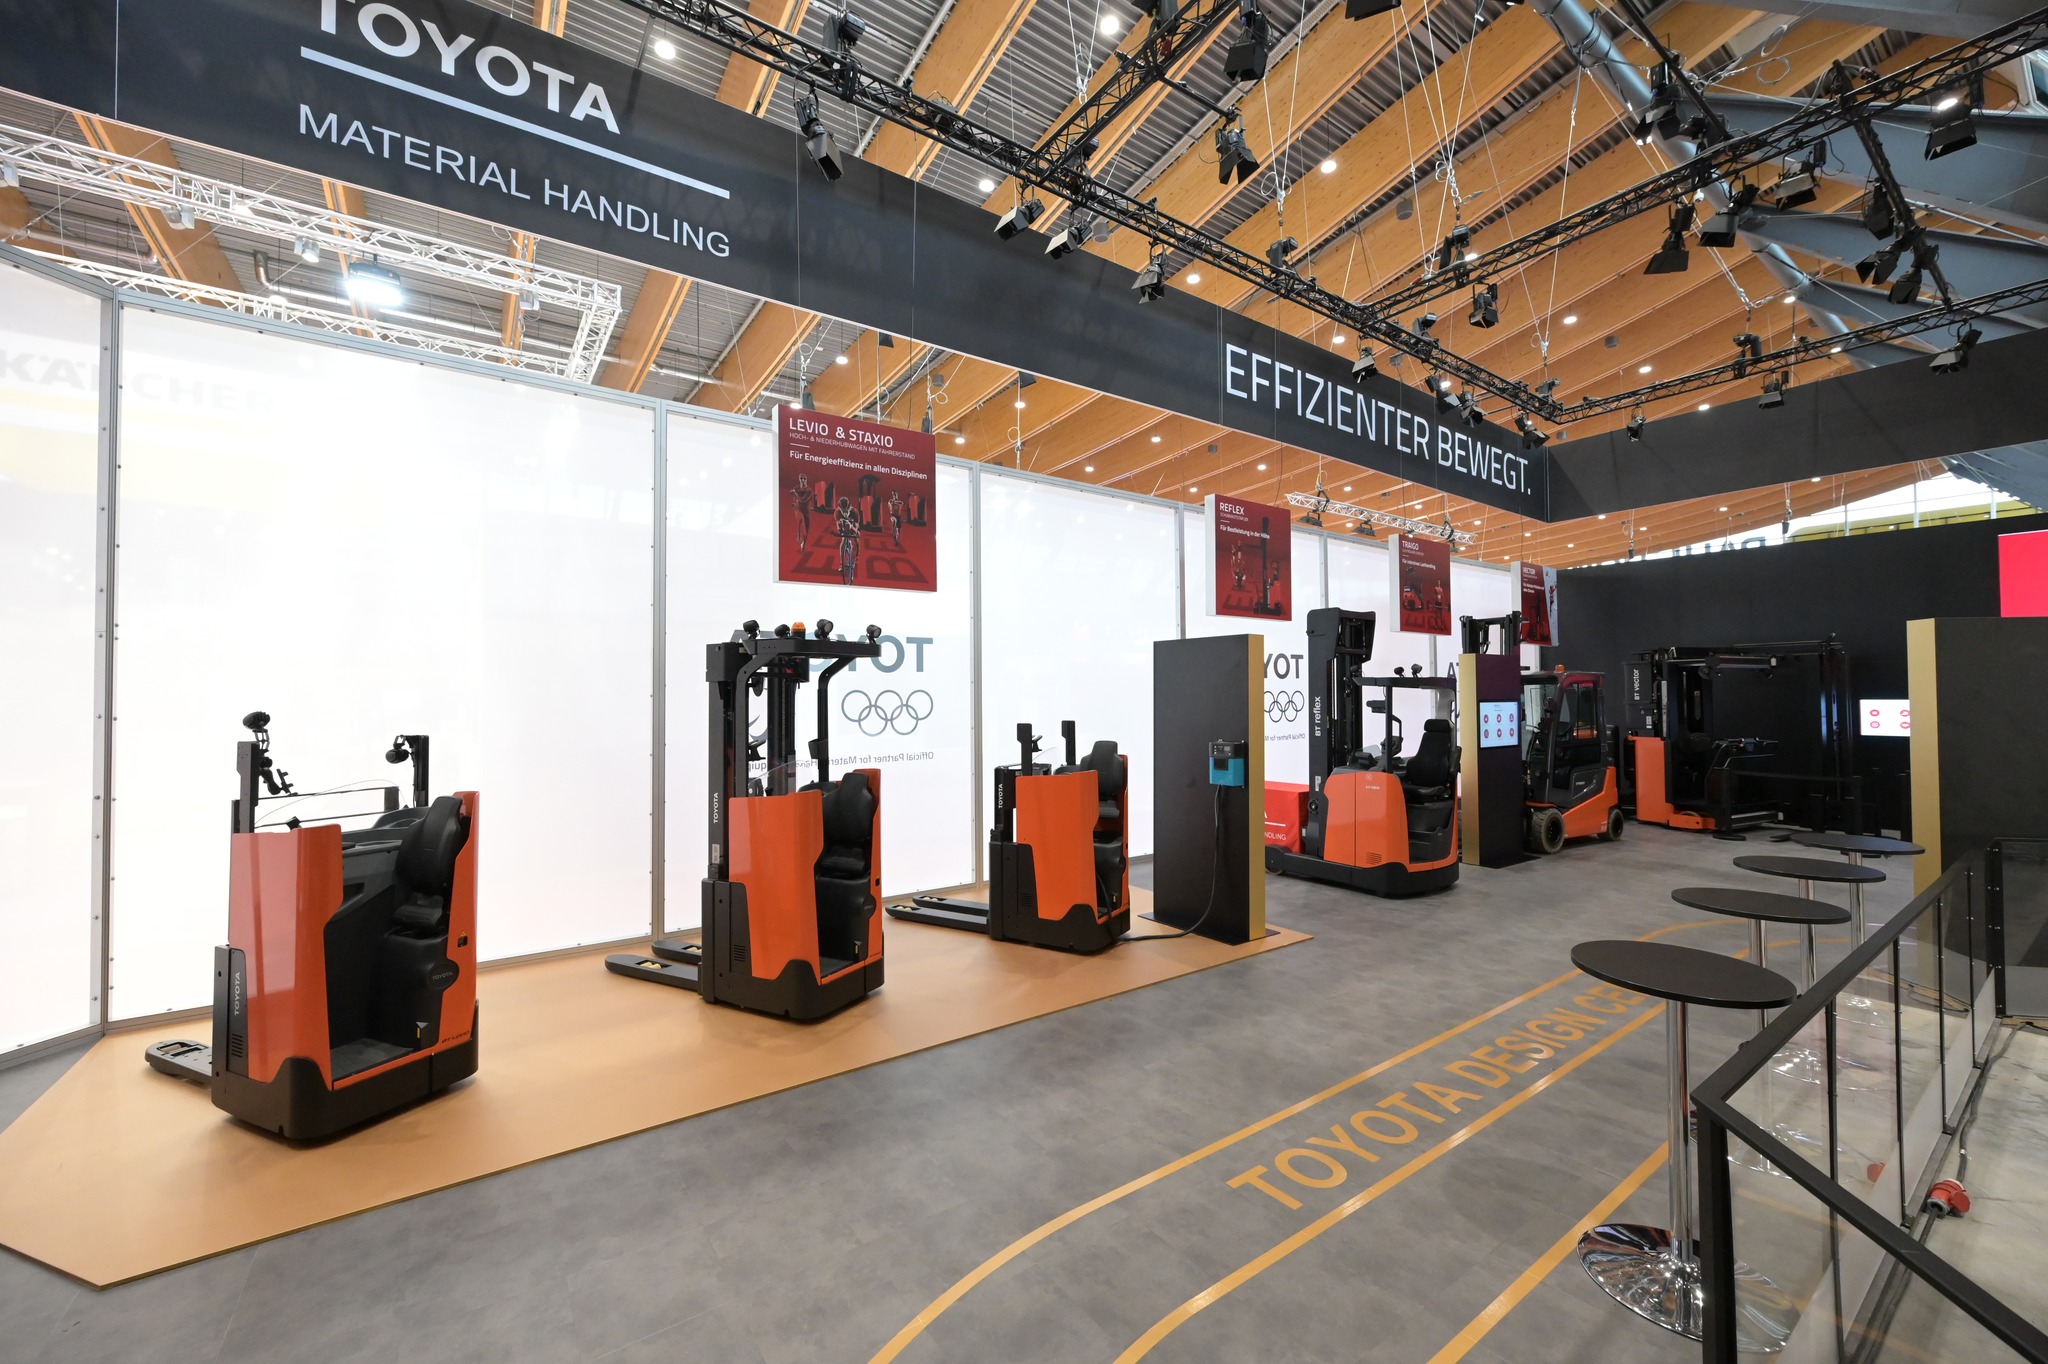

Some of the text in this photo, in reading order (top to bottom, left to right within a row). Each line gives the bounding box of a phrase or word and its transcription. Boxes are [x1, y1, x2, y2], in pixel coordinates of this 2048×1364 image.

[315, 0, 621, 134] TOYOTA
[300, 104, 730, 257] MATERIAL HANDLING
[789, 417, 894, 448] LEVIO & STAXIO
[1226, 343, 1532, 495] EFFIZIENTER BEWEGT.
[789, 450, 928, 480] Für Energieeffizienz in allen Disziplinen
[815, 436, 868, 452] NIEDERHUBWAGEN
[868, 446, 878, 454] MIT
[878, 448, 916, 460] FAHRERSTAND
[1219, 502, 1245, 515] REFLEX
[1312, 696, 1322, 737] BT reflex
[1226, 983, 1650, 1211] TOYOTA DESIGN CE
